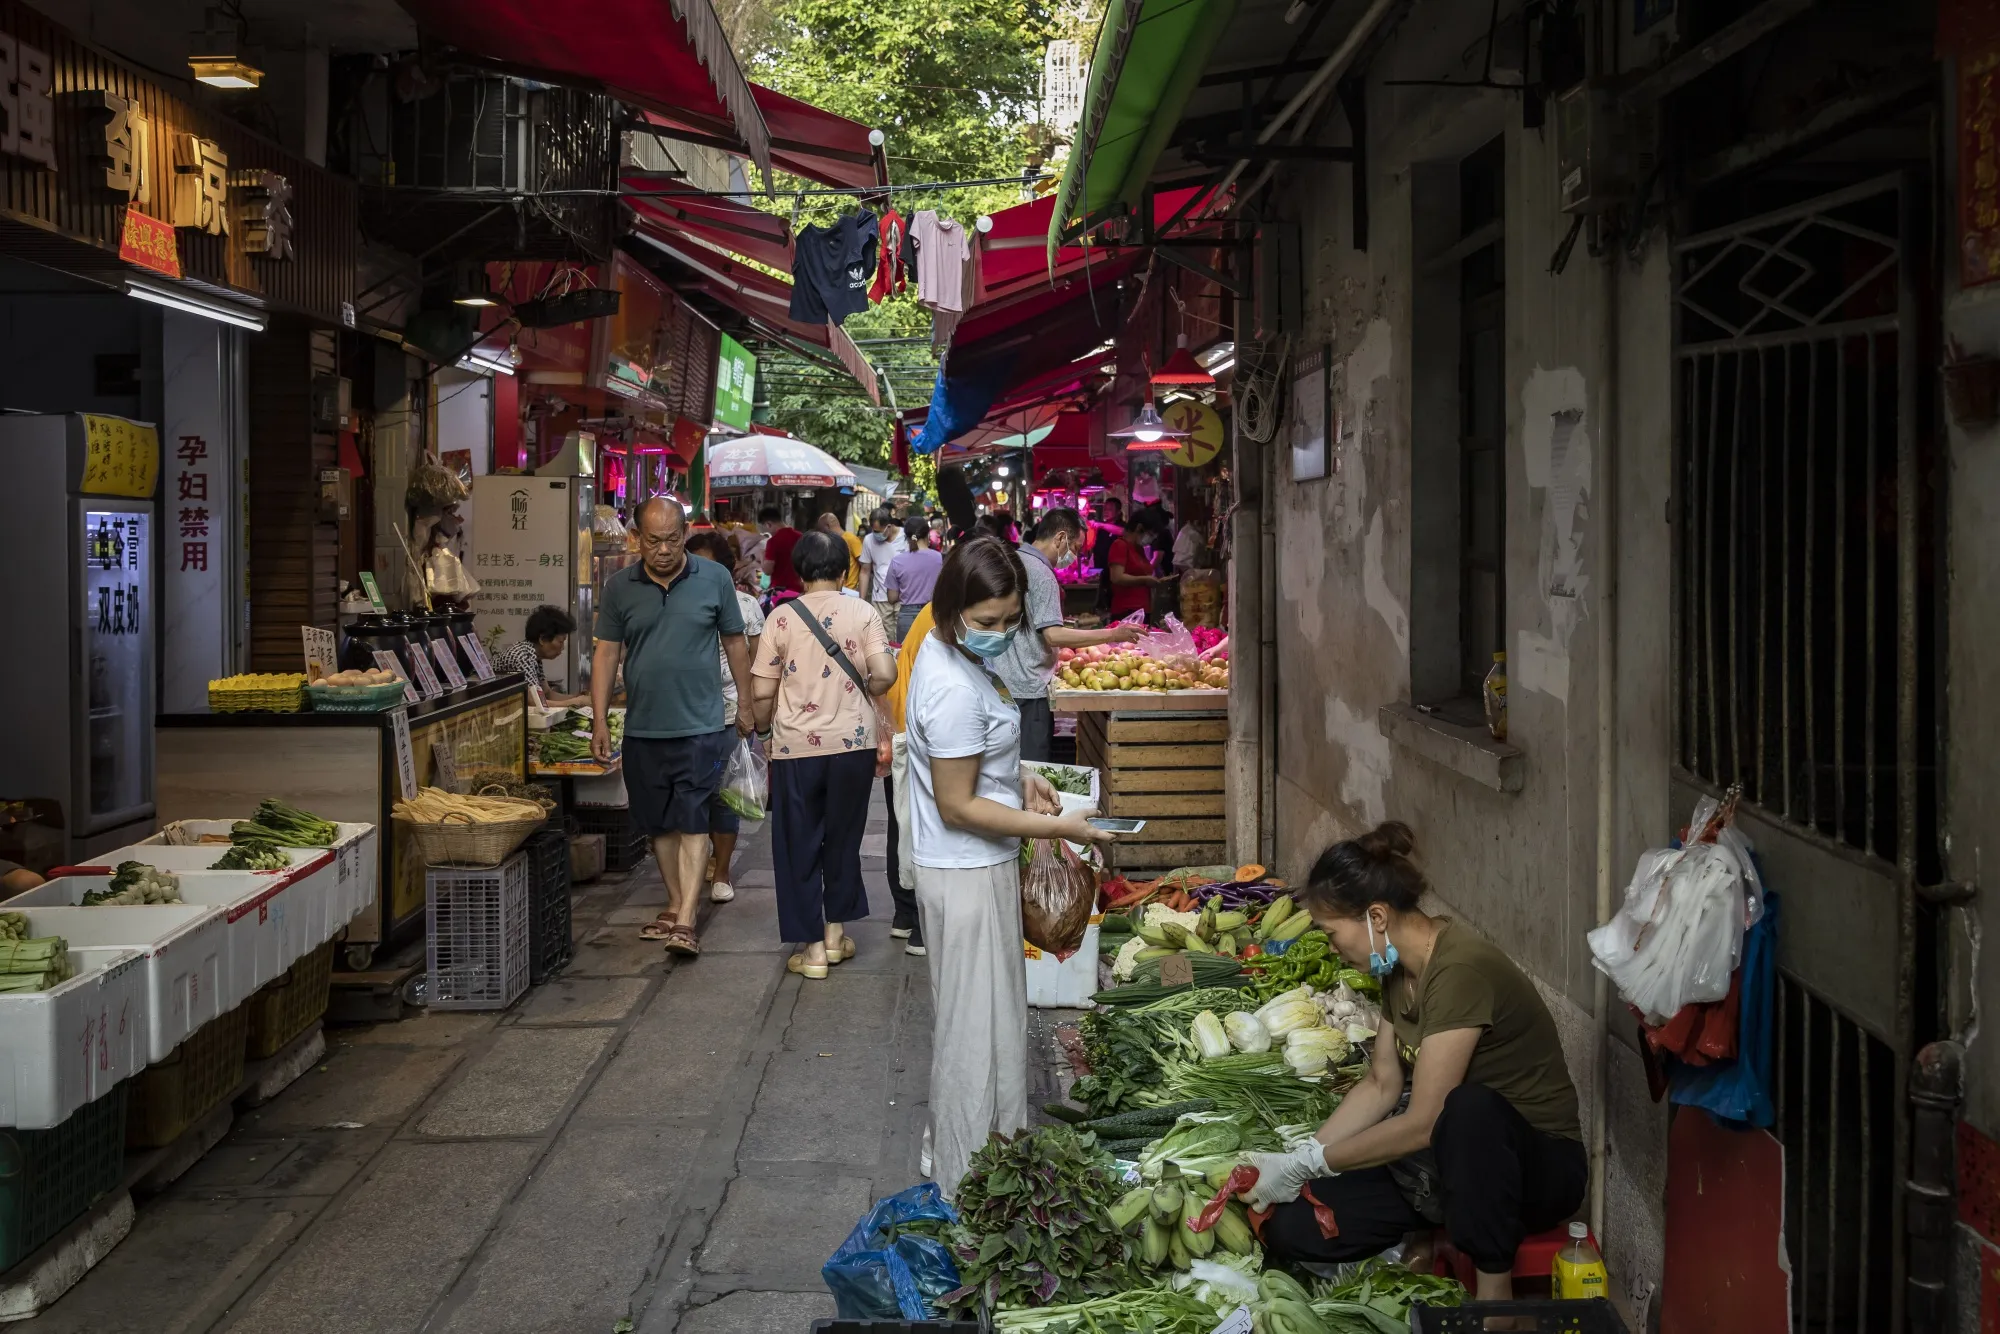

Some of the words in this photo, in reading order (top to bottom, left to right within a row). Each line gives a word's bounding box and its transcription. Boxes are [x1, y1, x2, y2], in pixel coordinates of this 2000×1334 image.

[177, 435, 209, 572] 孕妇禁用
[511, 496, 528, 530] 畅轻
[98, 582, 139, 635] 双皮奶
